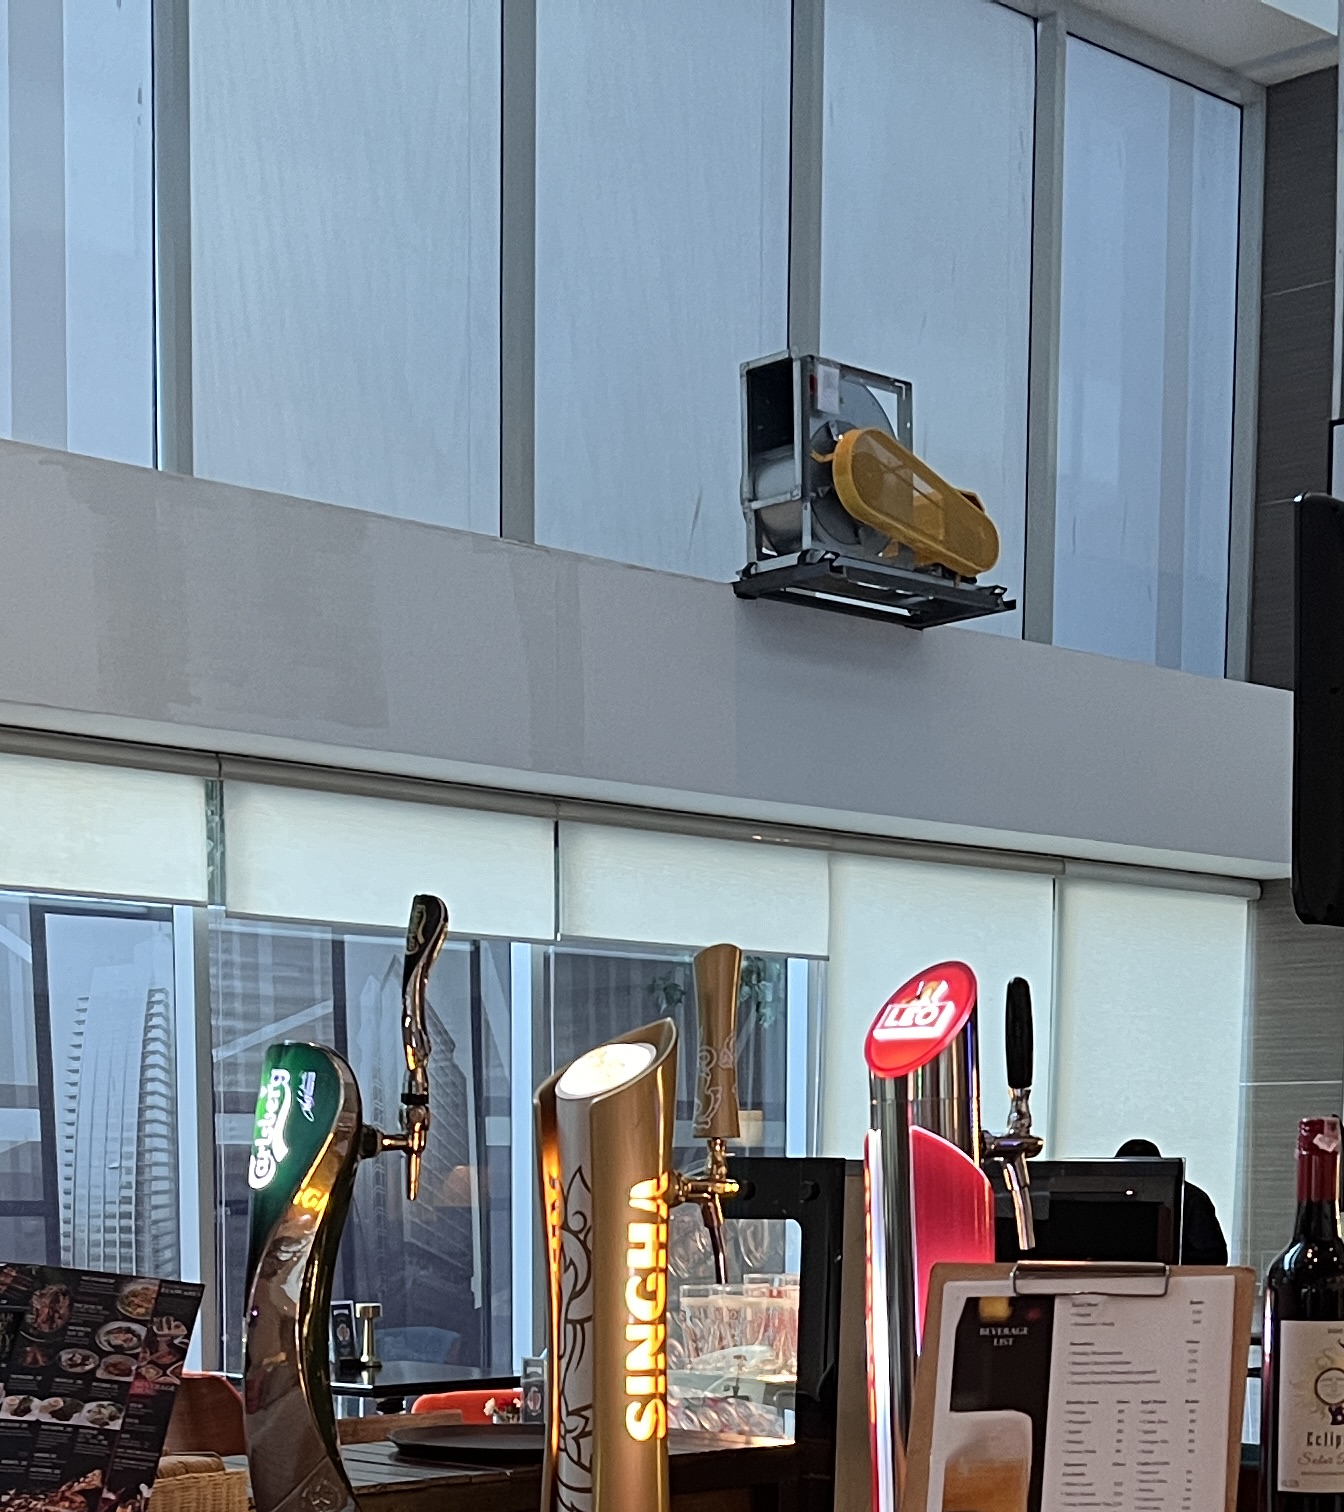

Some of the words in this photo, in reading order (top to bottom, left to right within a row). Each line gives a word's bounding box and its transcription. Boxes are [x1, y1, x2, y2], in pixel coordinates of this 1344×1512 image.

[884, 1005, 940, 1027] LEO
[248, 1068, 292, 1190] Carlsberg
[624, 1171, 669, 1442] SINGHA
[993, 1337, 1014, 1347] LIST
